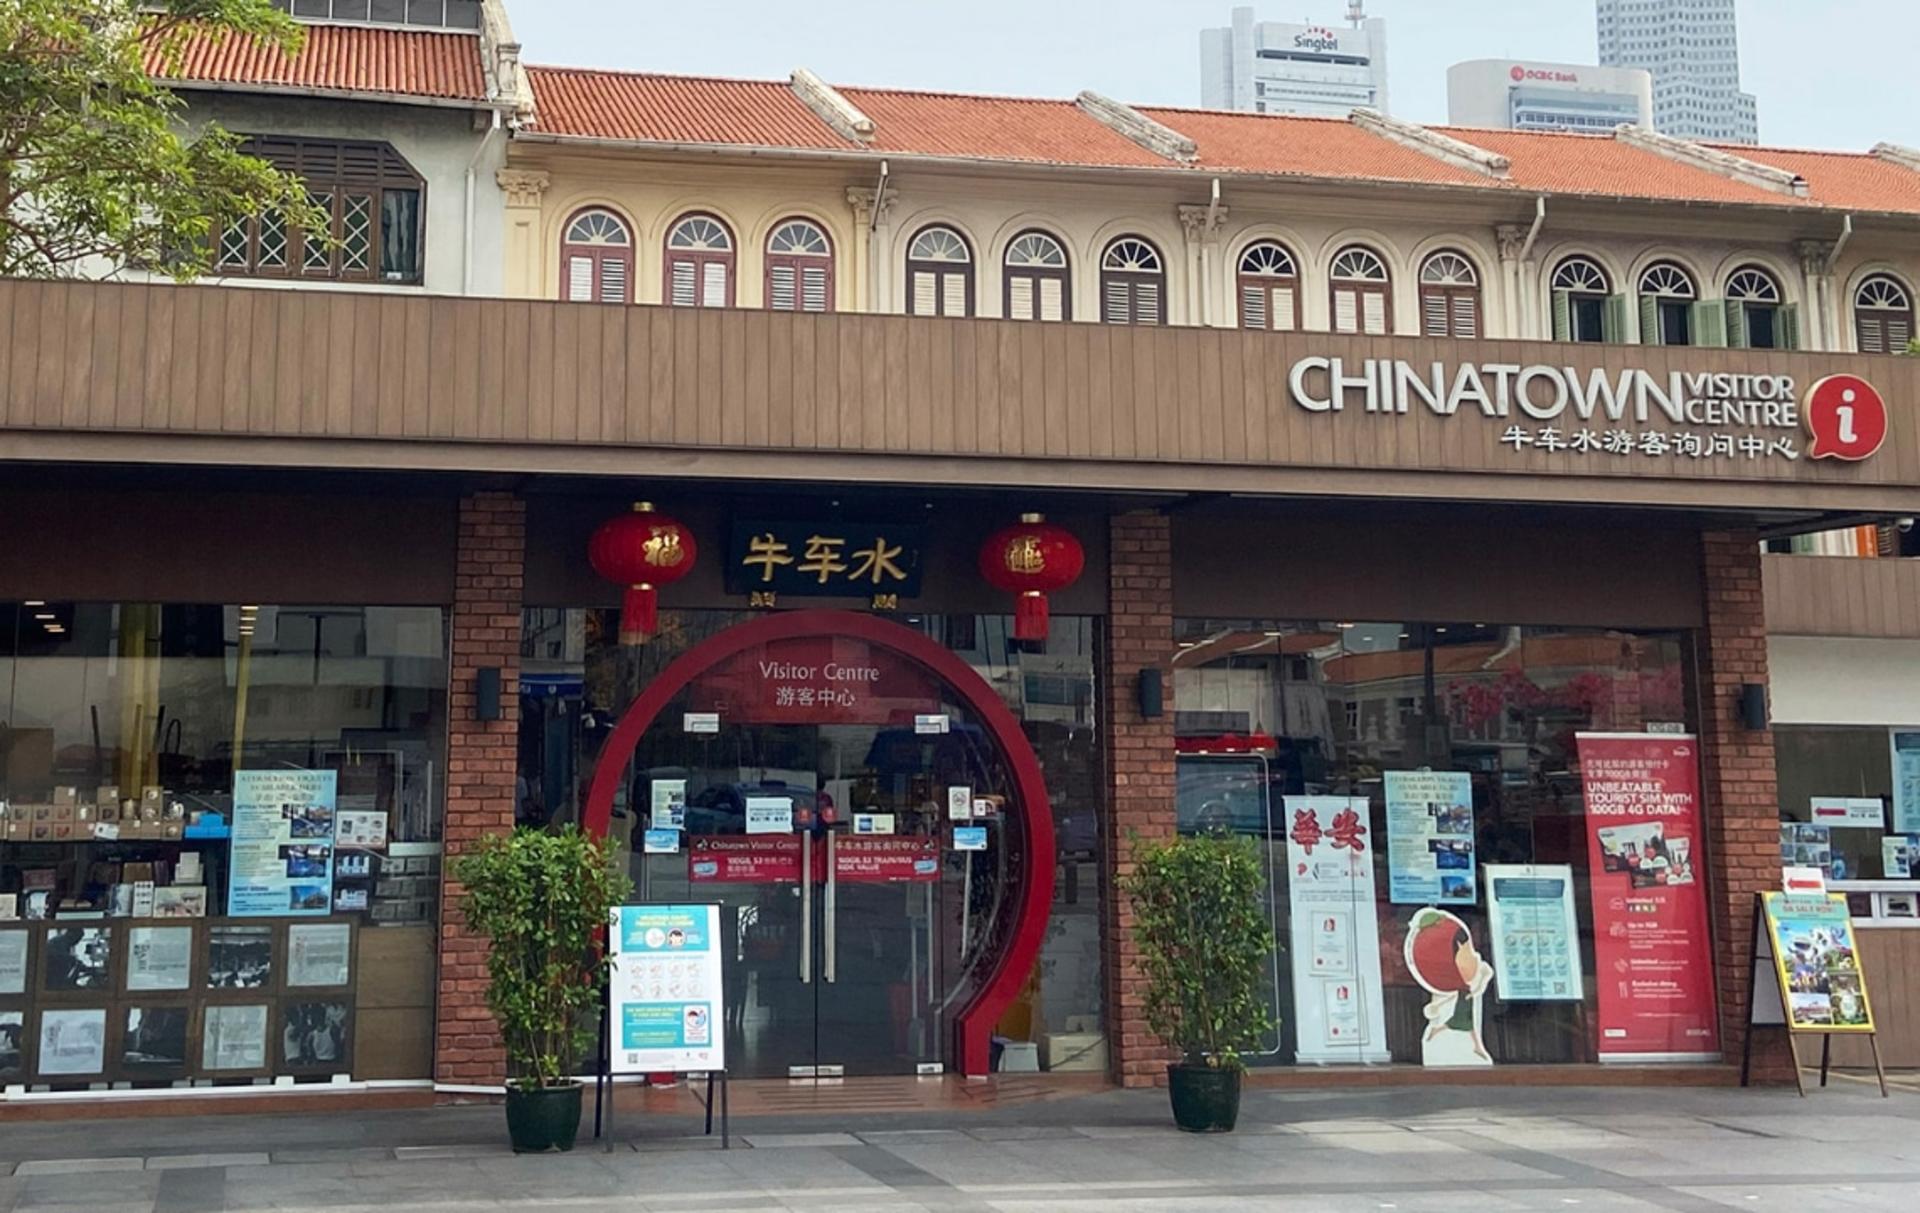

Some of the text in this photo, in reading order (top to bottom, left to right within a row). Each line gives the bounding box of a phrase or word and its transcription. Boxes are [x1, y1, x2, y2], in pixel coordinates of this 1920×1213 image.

[1294, 35, 1338, 52] Singtel
[1289, 356, 1685, 423] CHINATOWN
[1684, 372, 1795, 400] VISITOR
[1685, 400, 1798, 427] CENTRE
[1501, 425, 1799, 460] 牛车水游客询问中心
[742, 532, 908, 584] 牛车水
[759, 661, 880, 681] Visitor Centre
[776, 686, 856, 707] 游客中心
[1587, 782, 1662, 793] UNBEATABLE
[1589, 793, 1693, 804] TOURIST SIM WITH
[1590, 804, 1625, 815] 100GB
[1627, 804, 1644, 815] 4G
